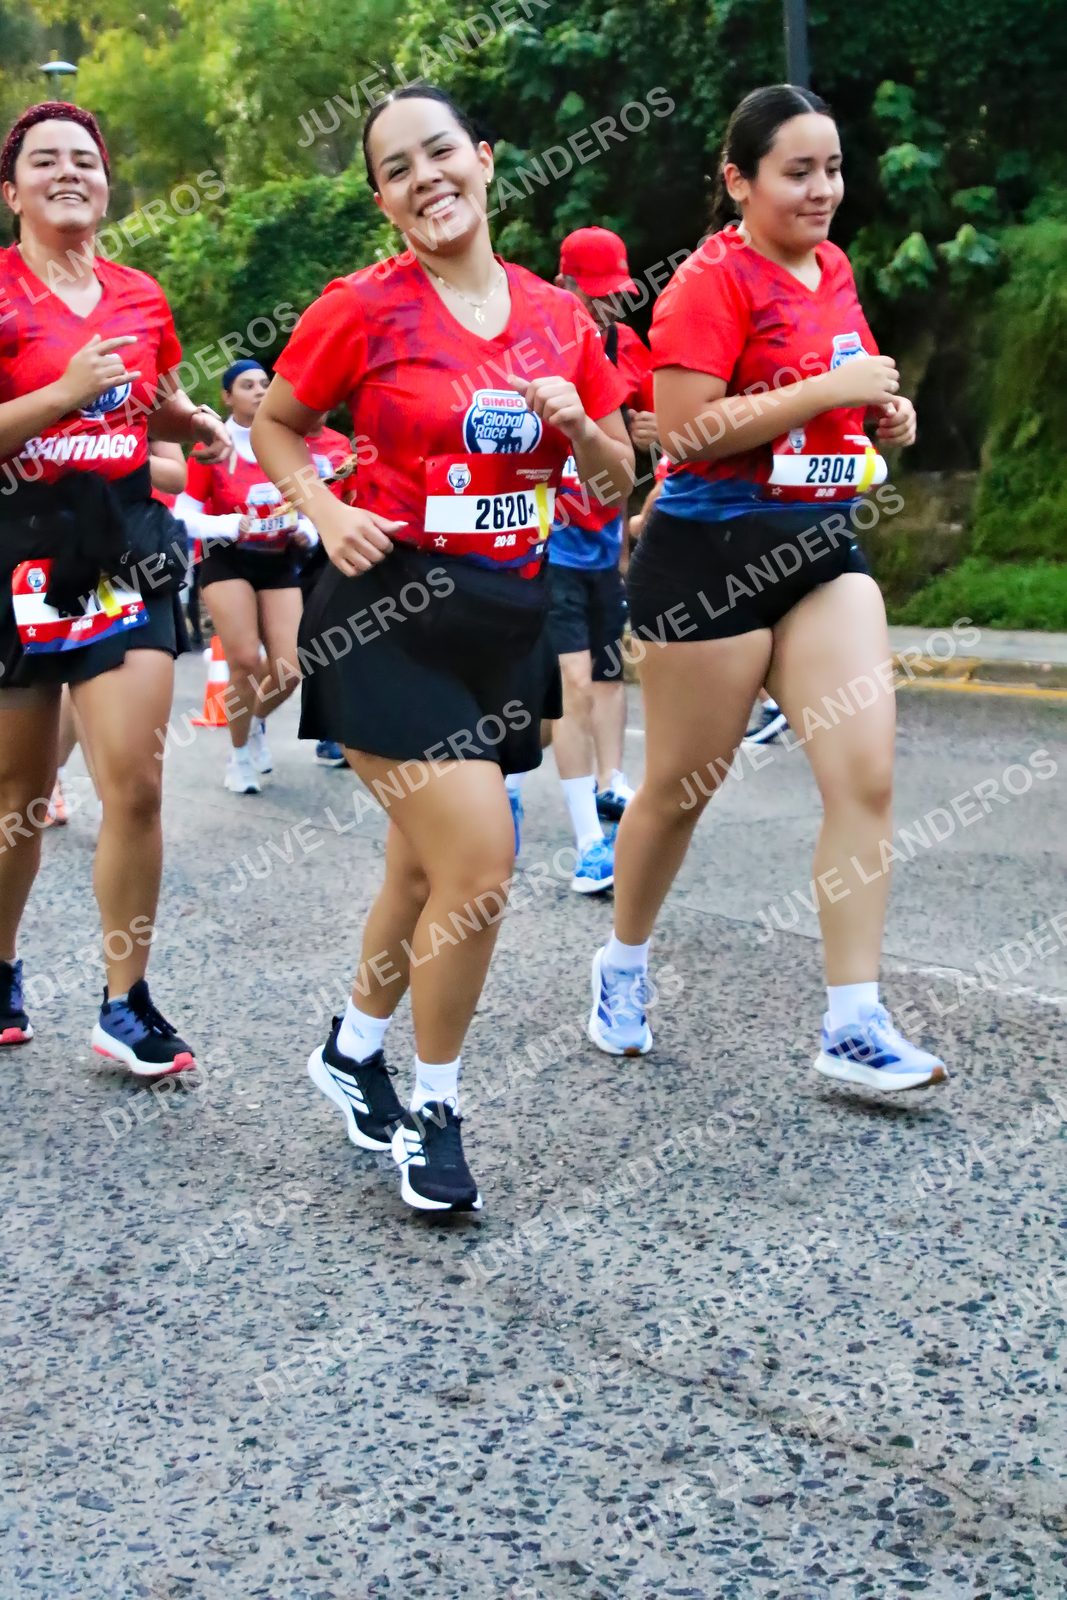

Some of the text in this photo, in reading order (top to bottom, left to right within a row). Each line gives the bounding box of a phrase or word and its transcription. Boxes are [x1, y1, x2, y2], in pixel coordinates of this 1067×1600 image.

[481, 396, 524, 408] BIMBO
[482, 411, 524, 428] Global
[475, 424, 507, 439] Race
[20, 434, 138, 460] SANTIAGO
[805, 457, 856, 483] 2304
[475, 493, 528, 530] 2620
